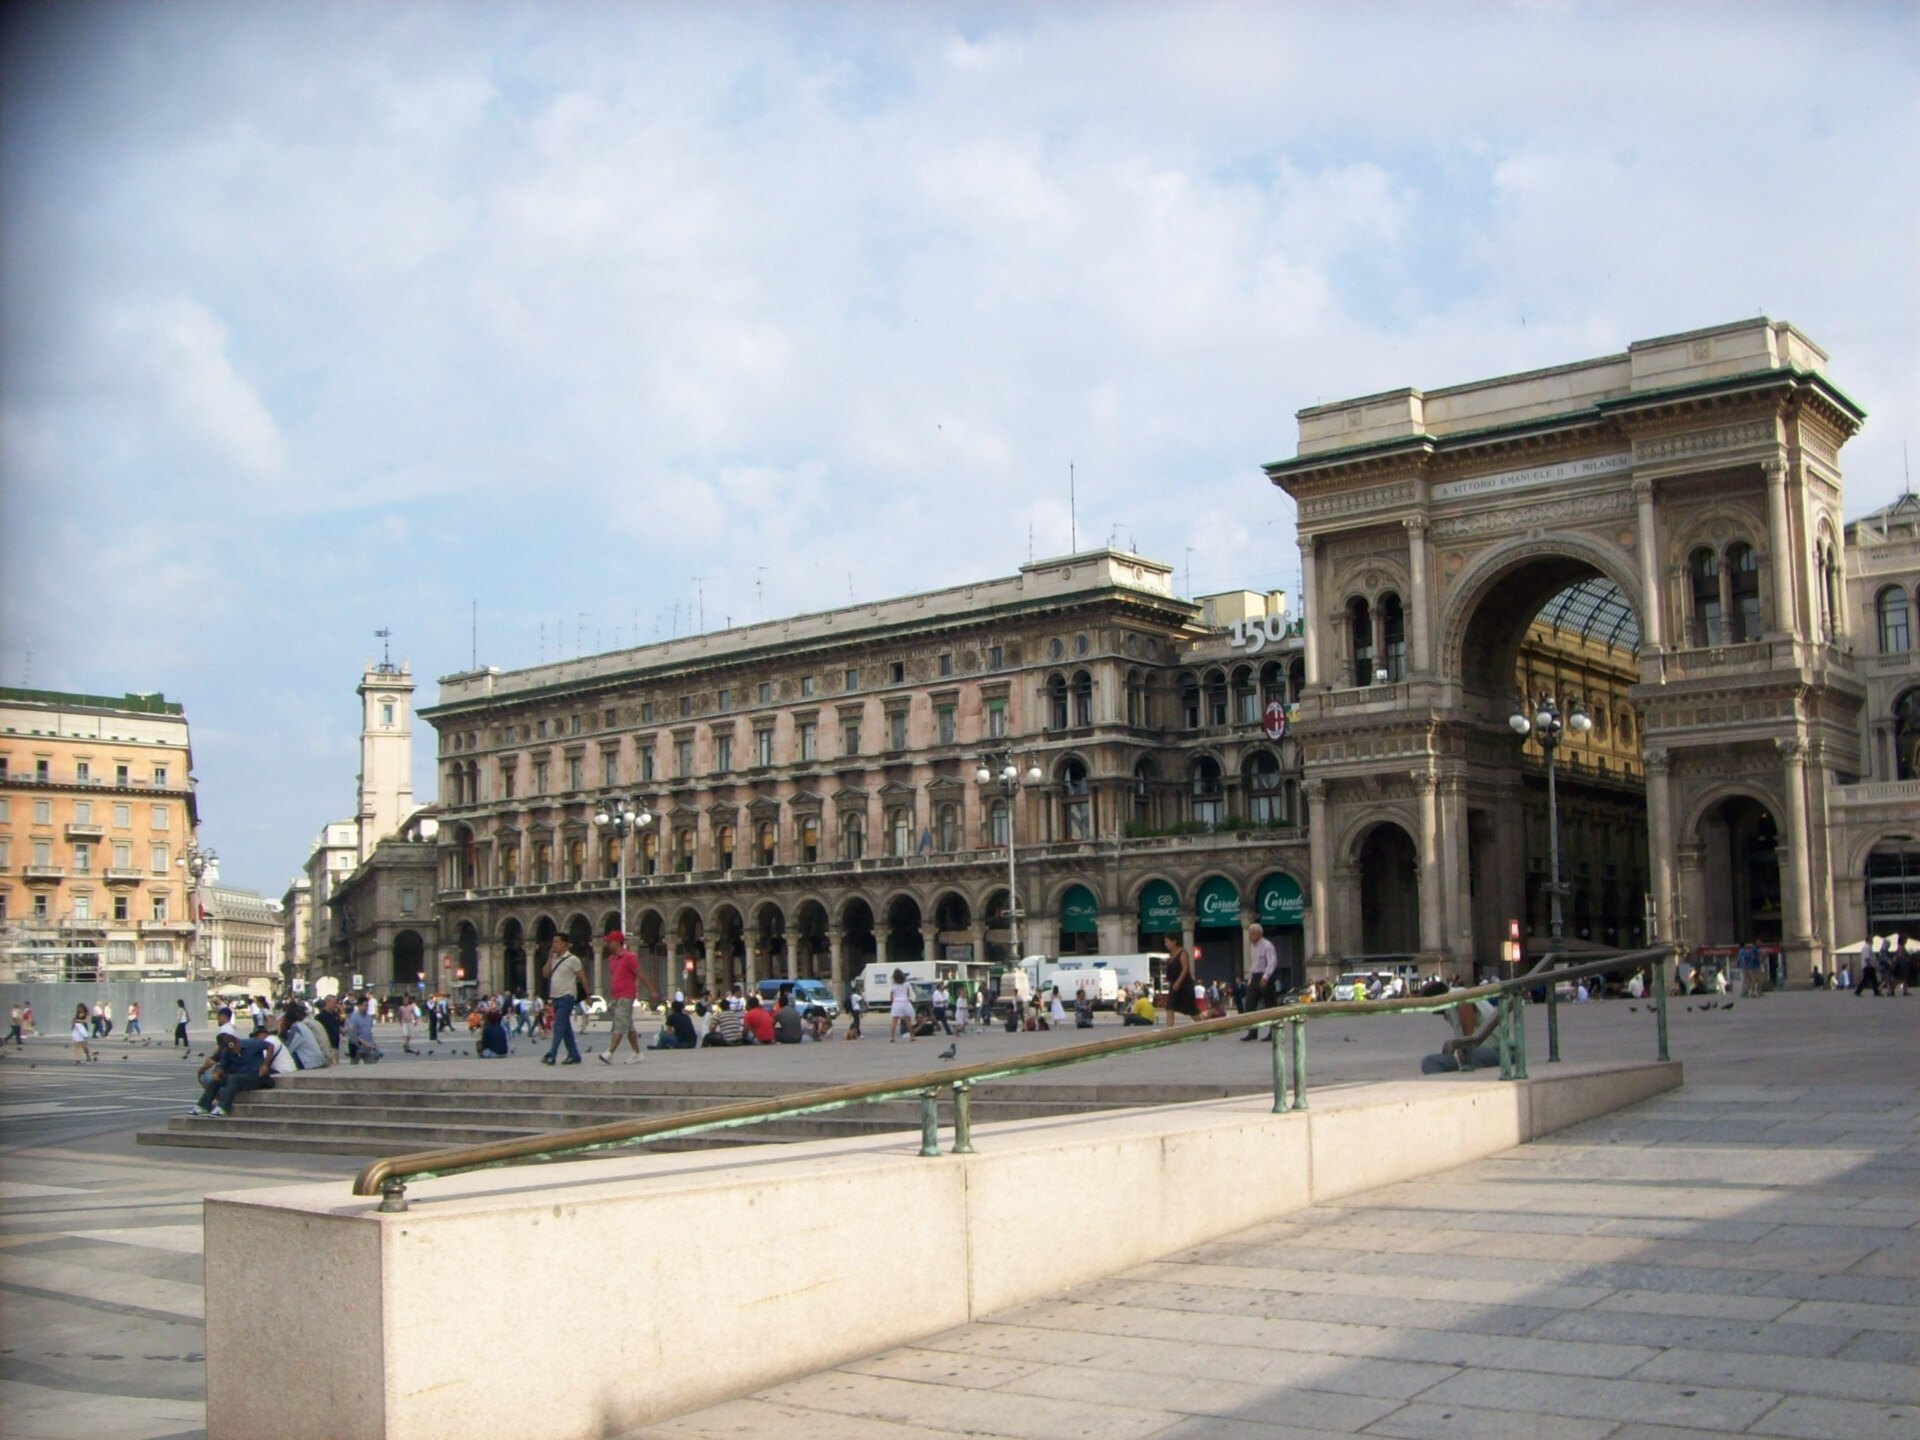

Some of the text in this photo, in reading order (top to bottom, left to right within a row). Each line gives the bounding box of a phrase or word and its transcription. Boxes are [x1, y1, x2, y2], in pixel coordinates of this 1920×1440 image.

[1453, 479, 1496, 492] VITTORIO
[1500, 470, 1550, 486] EMANUELE
[1582, 455, 1628, 471] MILANESI
